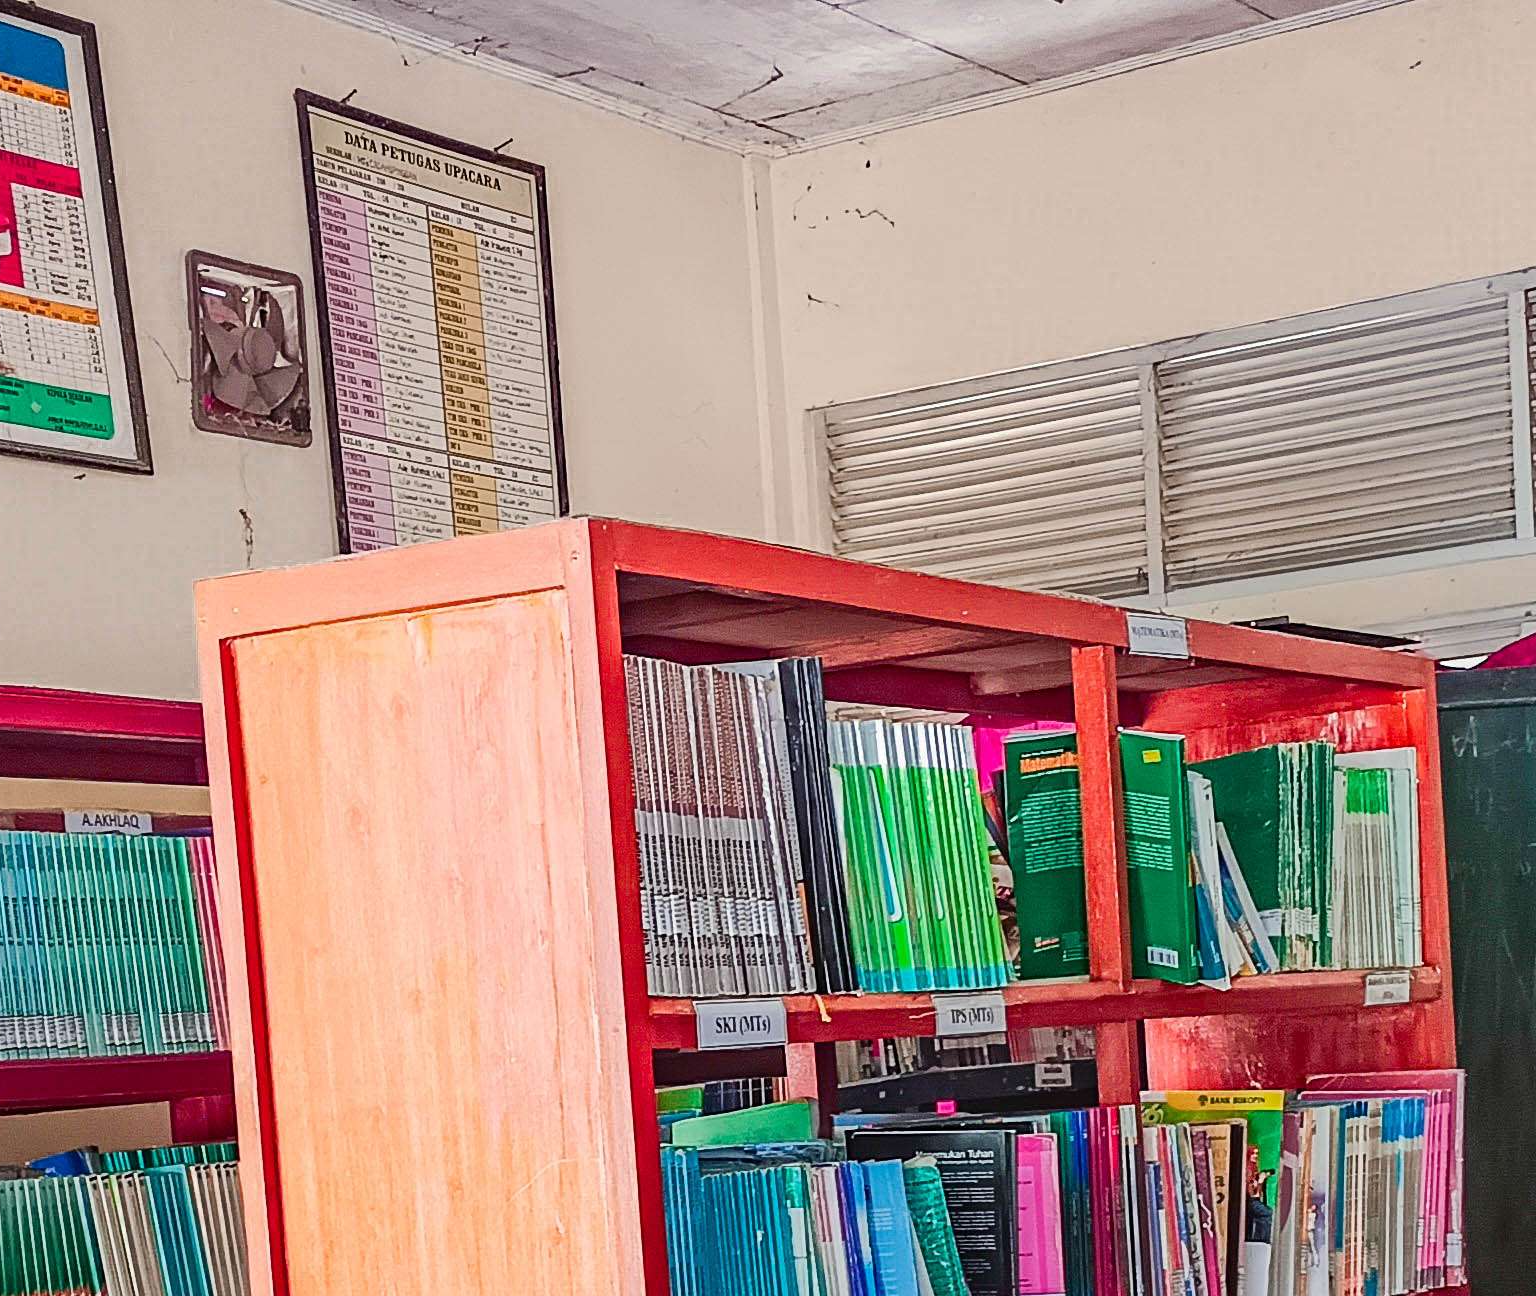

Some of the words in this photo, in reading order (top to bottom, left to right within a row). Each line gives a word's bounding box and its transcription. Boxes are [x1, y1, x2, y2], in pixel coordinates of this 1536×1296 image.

[344, 131, 378, 154] DATA
[381, 143, 441, 173] PETUGAS
[444, 162, 502, 192] UPACARA
[715, 1016, 738, 1034] SKI
[739, 1014, 771, 1036] (MTs)
[950, 1008, 967, 1024] IPS
[968, 1006, 994, 1025] (MTs)
[1210, 1096, 1231, 1105] BANK
[968, 1149, 994, 1159] Tuhan
